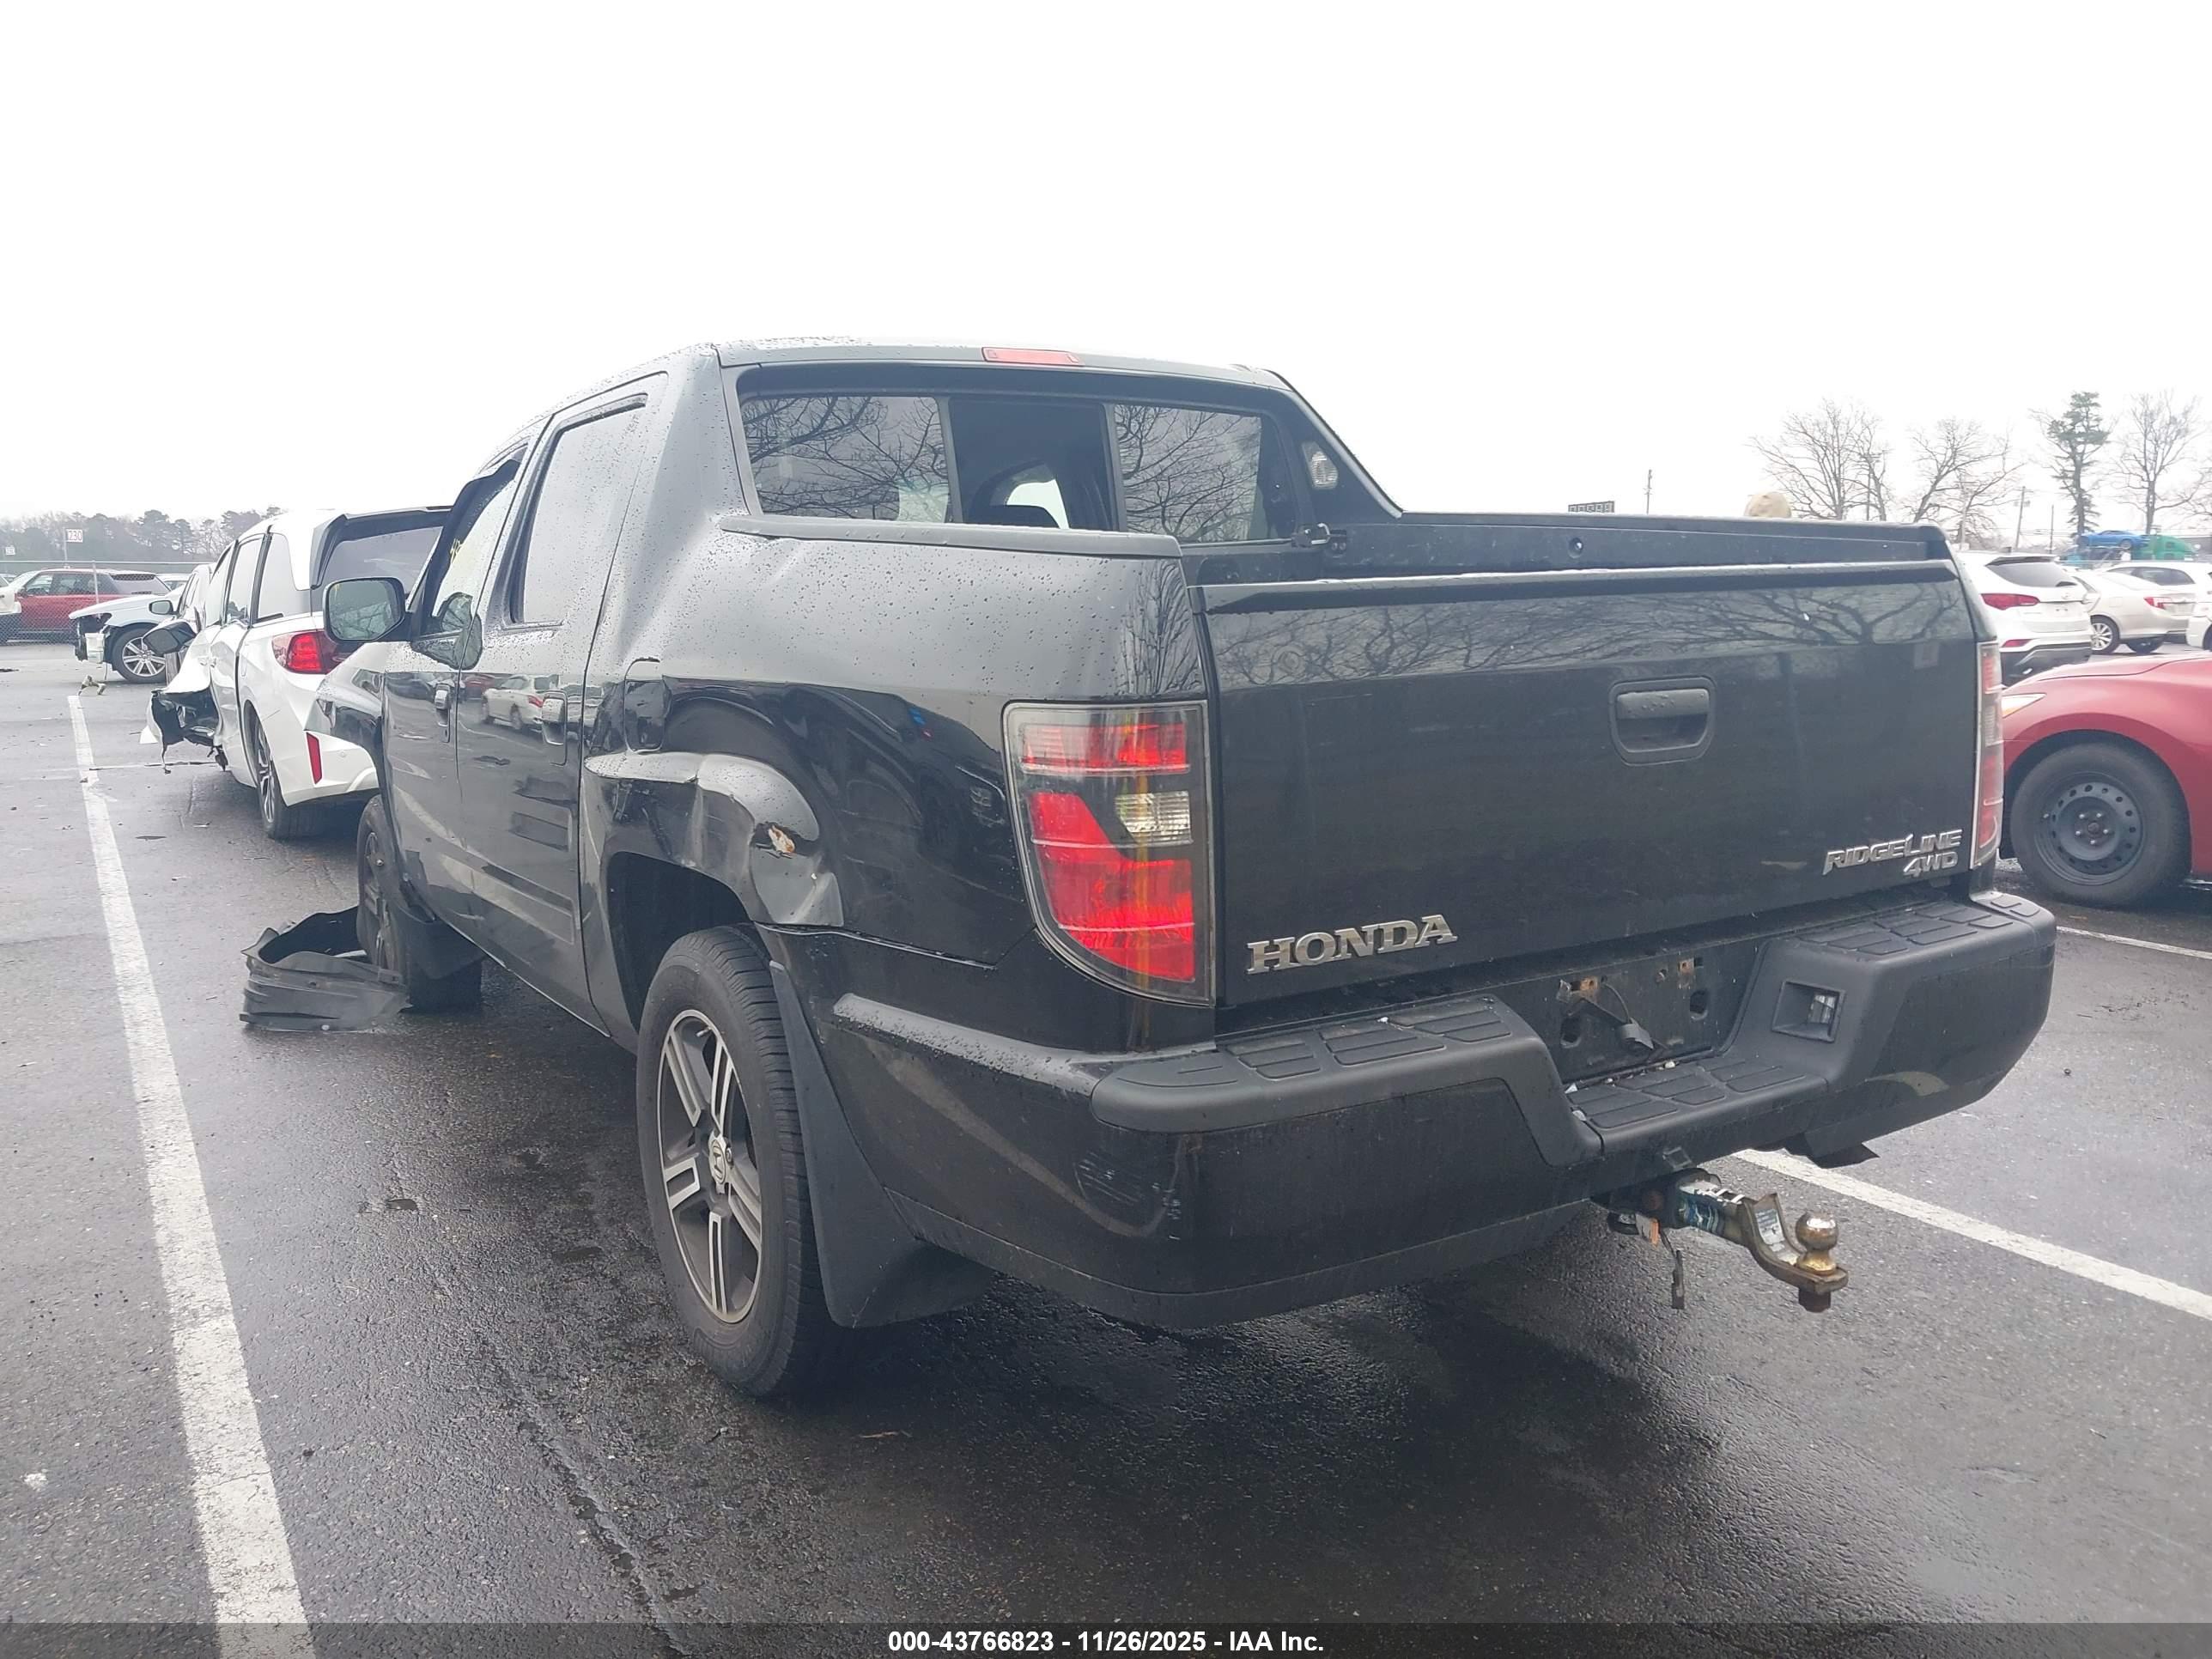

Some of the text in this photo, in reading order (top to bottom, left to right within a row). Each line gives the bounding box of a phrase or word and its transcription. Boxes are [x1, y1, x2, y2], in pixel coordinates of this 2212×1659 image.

[1822, 829, 1963, 876] RIDGELINE
[1903, 851, 1959, 878] 4WD
[1247, 915, 1457, 974] HONDA
